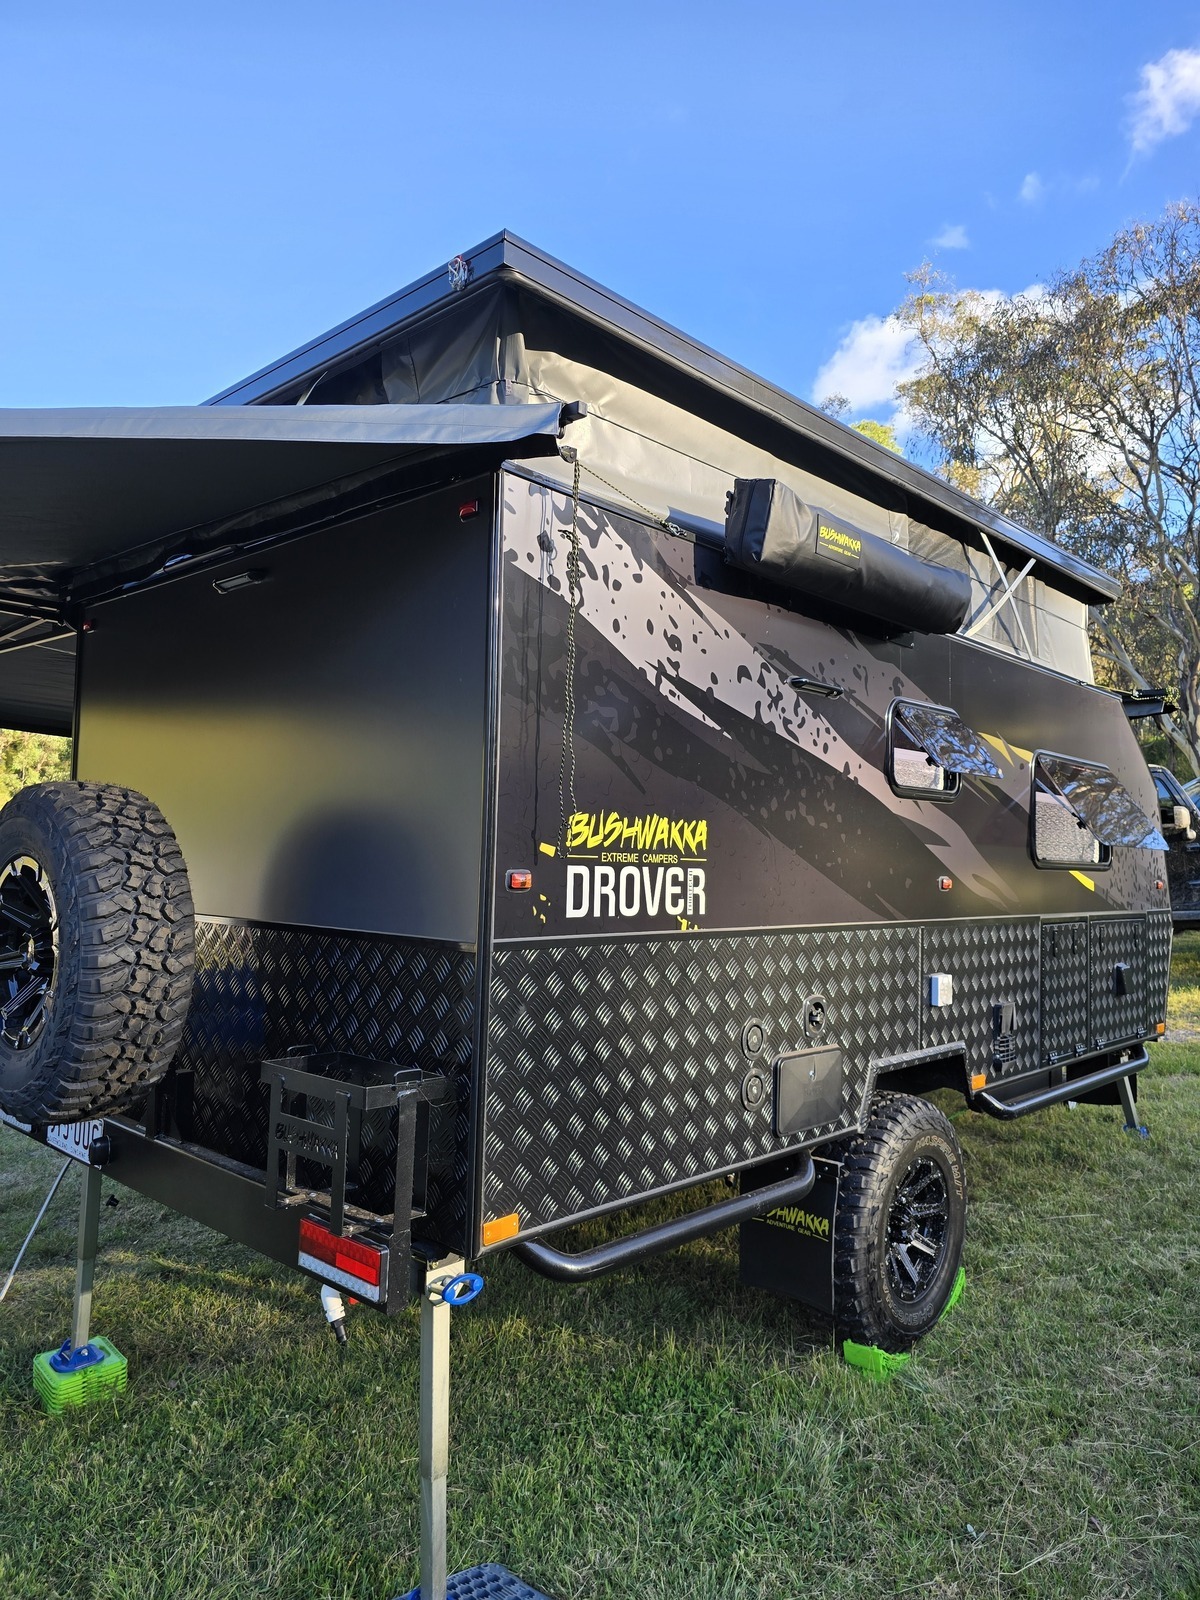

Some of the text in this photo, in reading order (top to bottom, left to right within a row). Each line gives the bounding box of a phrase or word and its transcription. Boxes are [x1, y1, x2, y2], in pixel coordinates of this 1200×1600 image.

[820, 526, 861, 552] BUSHWAKKA
[566, 809, 707, 855] BUSHWAKKA
[601, 852, 678, 864] EXTREME CAMPERS
[566, 865, 706, 918] DROVER
[766, 1219, 812, 1237] ADVENTURE GEAR
